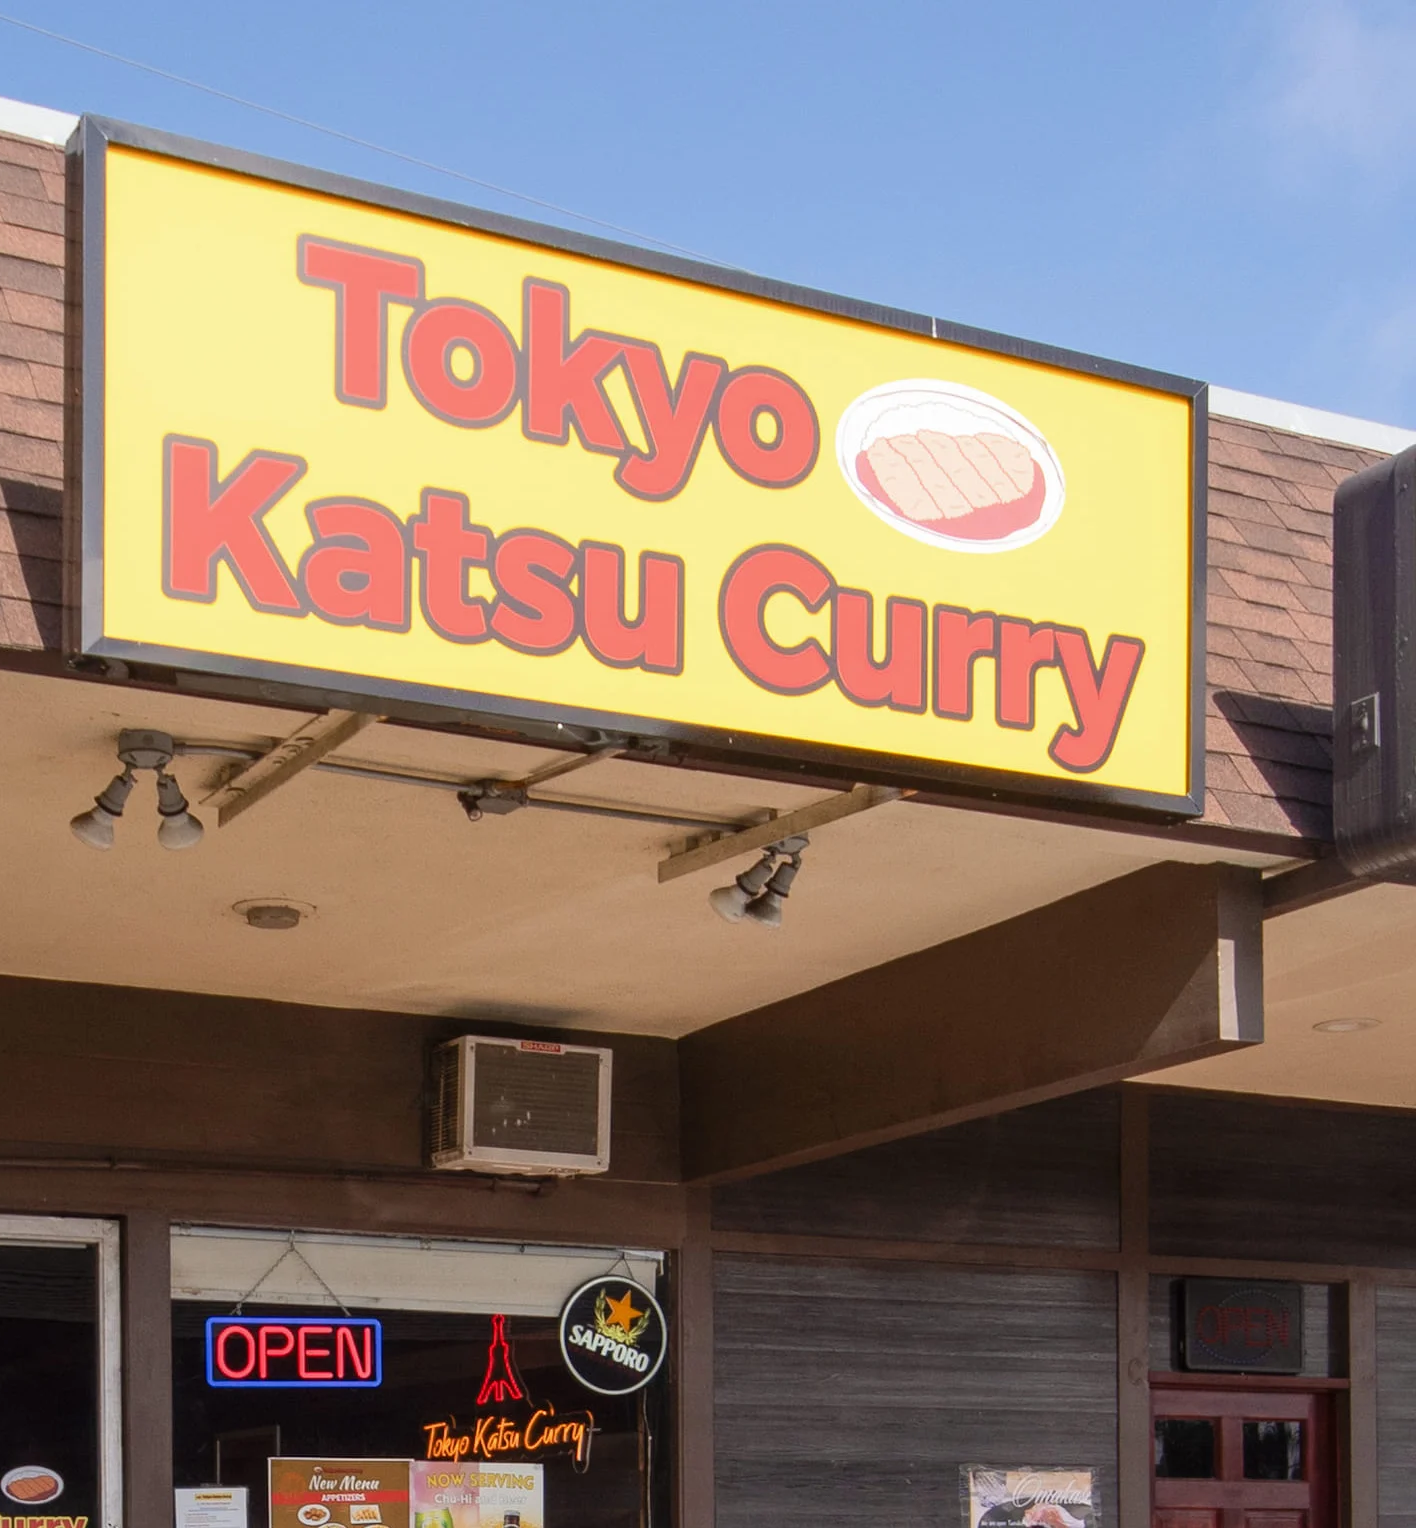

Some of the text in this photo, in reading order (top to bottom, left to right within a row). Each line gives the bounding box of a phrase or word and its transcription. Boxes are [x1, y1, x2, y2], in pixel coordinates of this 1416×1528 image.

[297, 233, 819, 501] Tokyo
[161, 434, 1146, 773] Katsu Curry
[568, 1324, 650, 1373] SAPPORO
[1196, 1305, 1290, 1349] OPEN
[217, 1325, 371, 1379] OPEN
[423, 1409, 585, 1462] Tokyo Katsu Curry
[308, 1475, 380, 1490] New Menu
[321, 1493, 366, 1502] APPETIZERS
[427, 1473, 534, 1490] NOW SERVING
[434, 1493, 472, 1504] Chu-Hi
